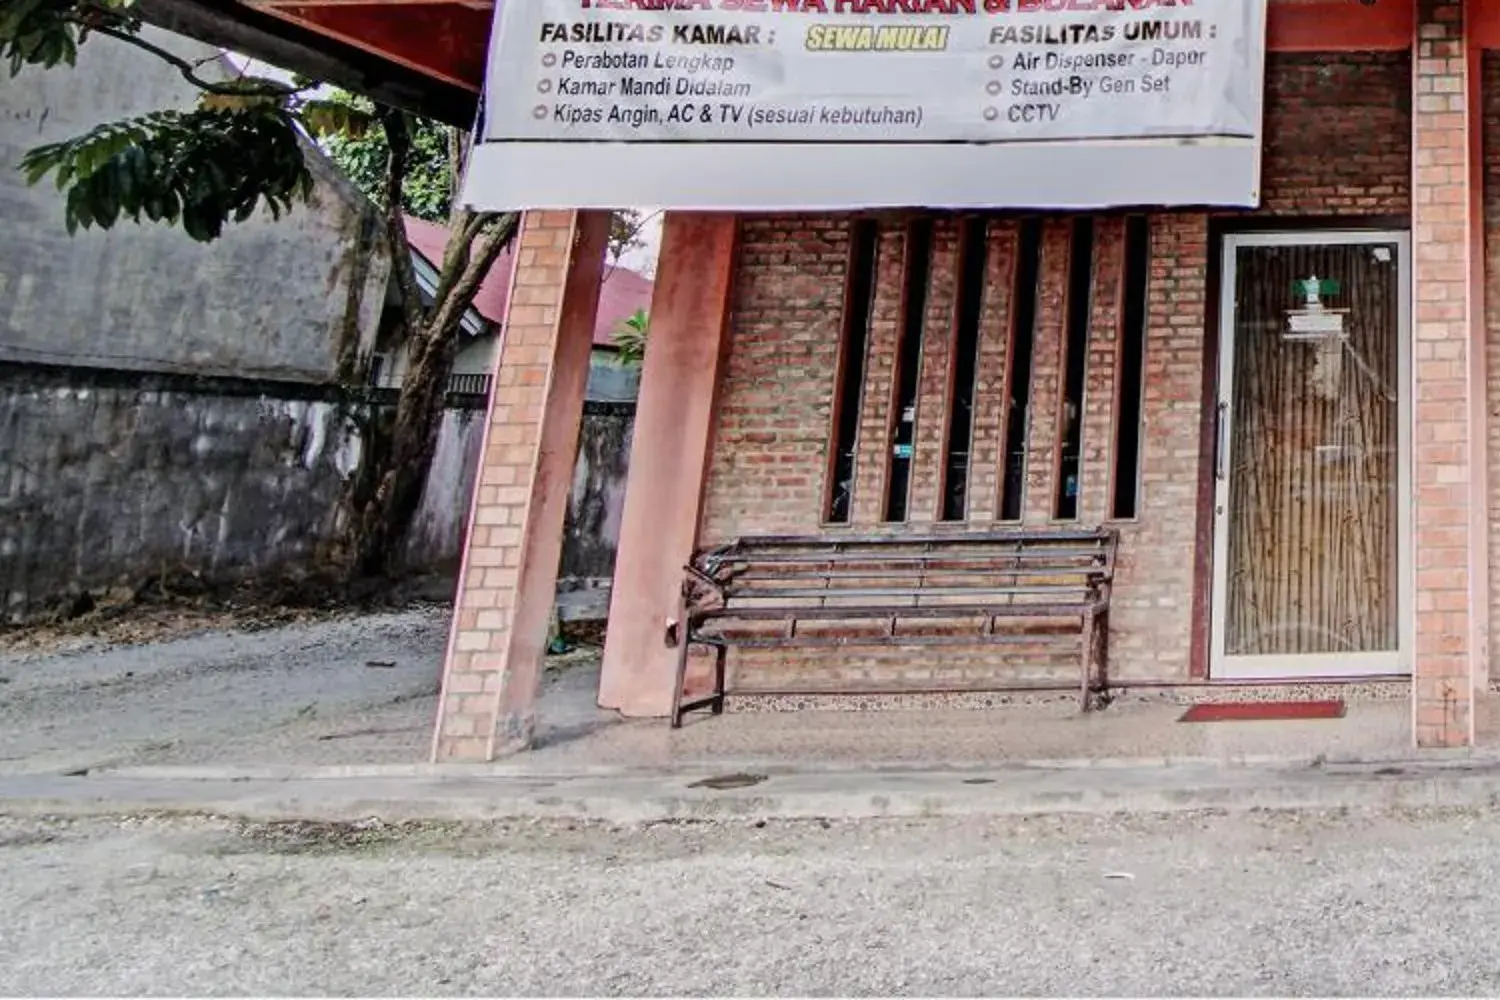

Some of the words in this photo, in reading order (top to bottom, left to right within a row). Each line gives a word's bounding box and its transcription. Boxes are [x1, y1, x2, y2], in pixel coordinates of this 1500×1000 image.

[539, 22, 664, 44] FASILITAS
[804, 24, 874, 51] SEWA
[874, 25, 951, 52] MULAI
[988, 23, 1116, 45] FASILITAS
[561, 50, 649, 69] Perabotan
[653, 51, 735, 73] Lengkap
[1012, 52, 1041, 71] Air
[1045, 51, 1135, 72] Dispenser
[1151, 47, 1207, 67] Dapur
[556, 76, 617, 96] Kamar
[619, 77, 672, 96] Mandi
[675, 77, 752, 97] Didalam
[1010, 74, 1094, 99] Stand-By
[1099, 76, 1136, 94] Gen
[1140, 74, 1171, 93] Set
[553, 104, 604, 124] Kipas
[607, 104, 664, 129] Angin,
[667, 104, 695, 122] AC
[699, 104, 713, 124] &
[718, 103, 745, 123] TV
[746, 104, 815, 129] (sesuai
[819, 104, 924, 129] kebutuhan)
[1006, 103, 1062, 123] CCTV
